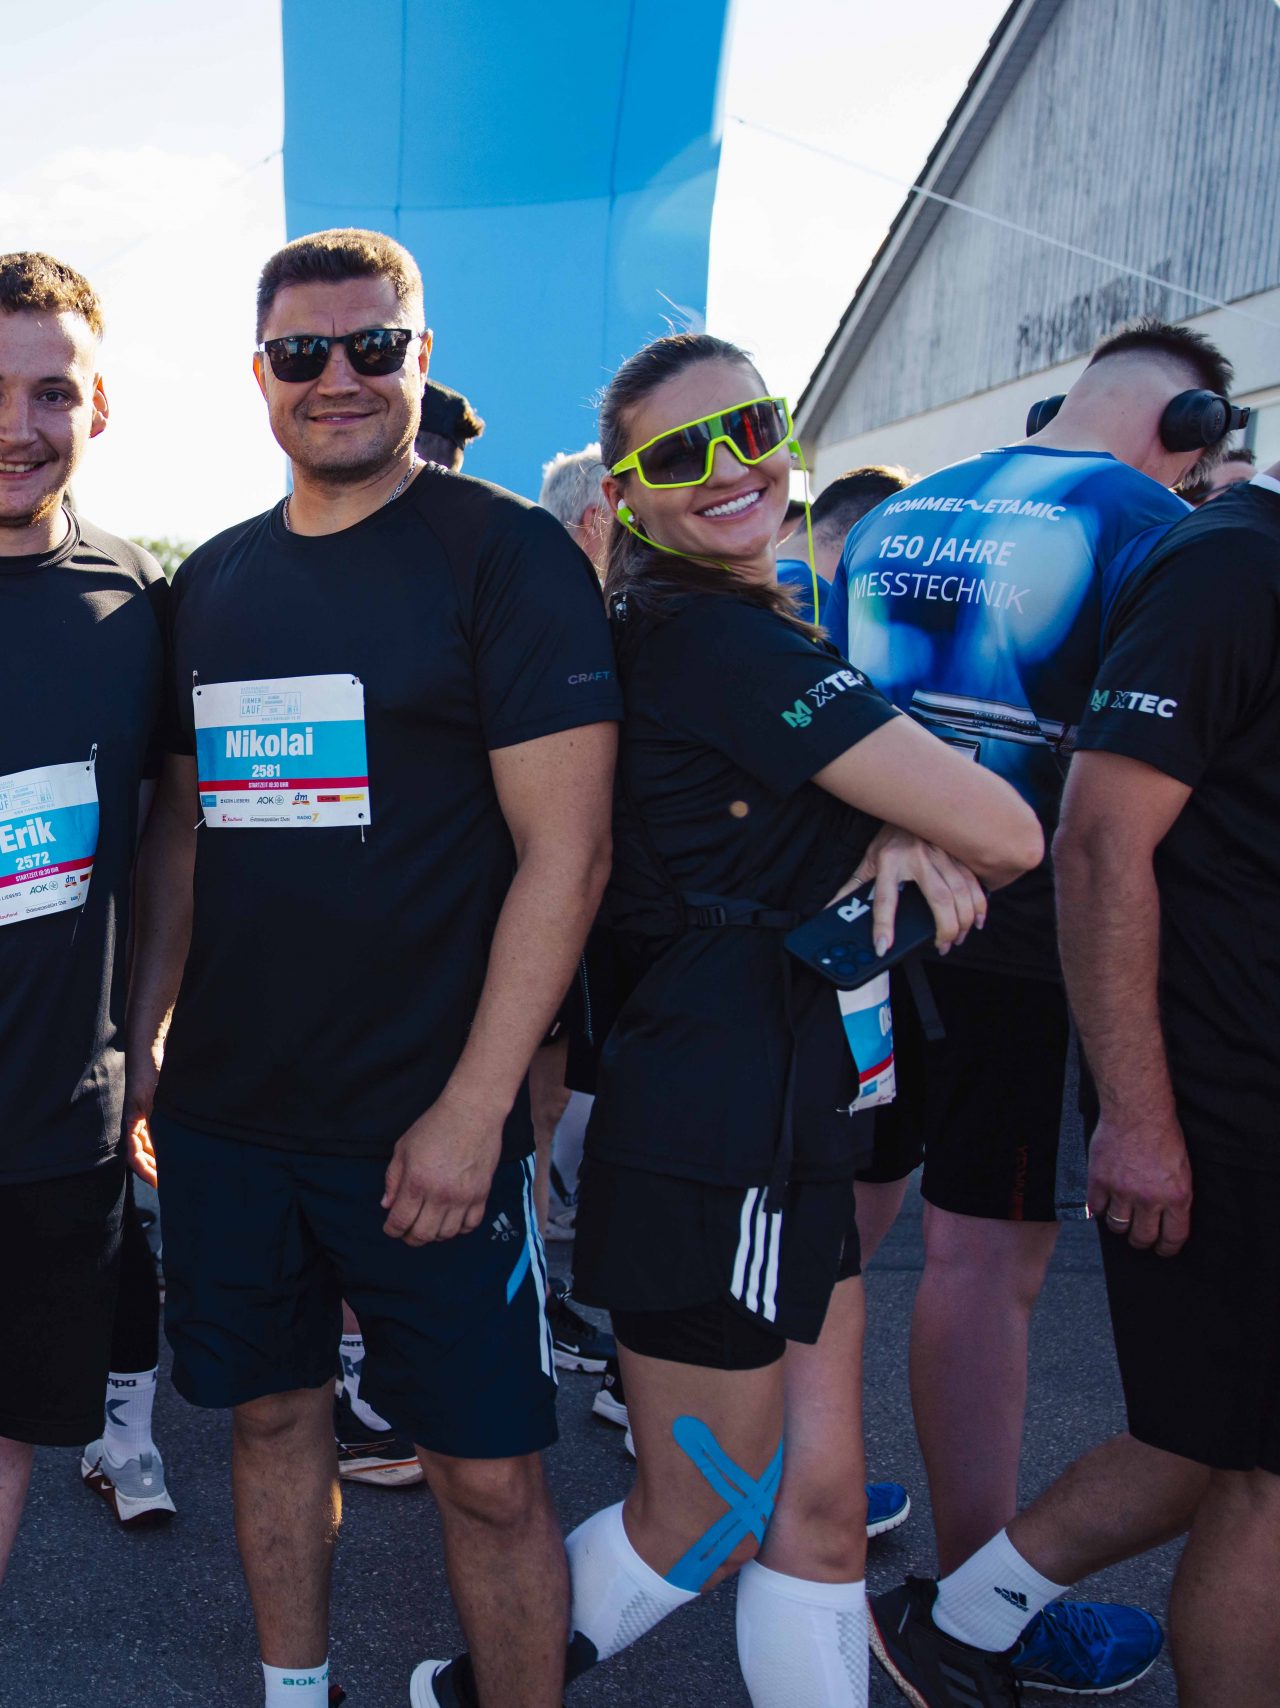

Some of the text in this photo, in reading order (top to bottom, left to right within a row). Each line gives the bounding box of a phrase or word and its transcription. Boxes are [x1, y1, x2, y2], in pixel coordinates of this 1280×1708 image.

[878, 535, 1016, 567] 150 JAHRE
[853, 571, 1031, 615] MESSTECHNIK
[567, 671, 609, 685] CRAFT
[1110, 690, 1178, 718] XTEC
[225, 727, 313, 758] Nikolai
[251, 764, 281, 778] 2581
[256, 796, 274, 805] AOK
[294, 792, 308, 801] dm
[16, 851, 51, 870] 2572
[65, 874, 76, 883] dm
[29, 883, 49, 895] AOK
